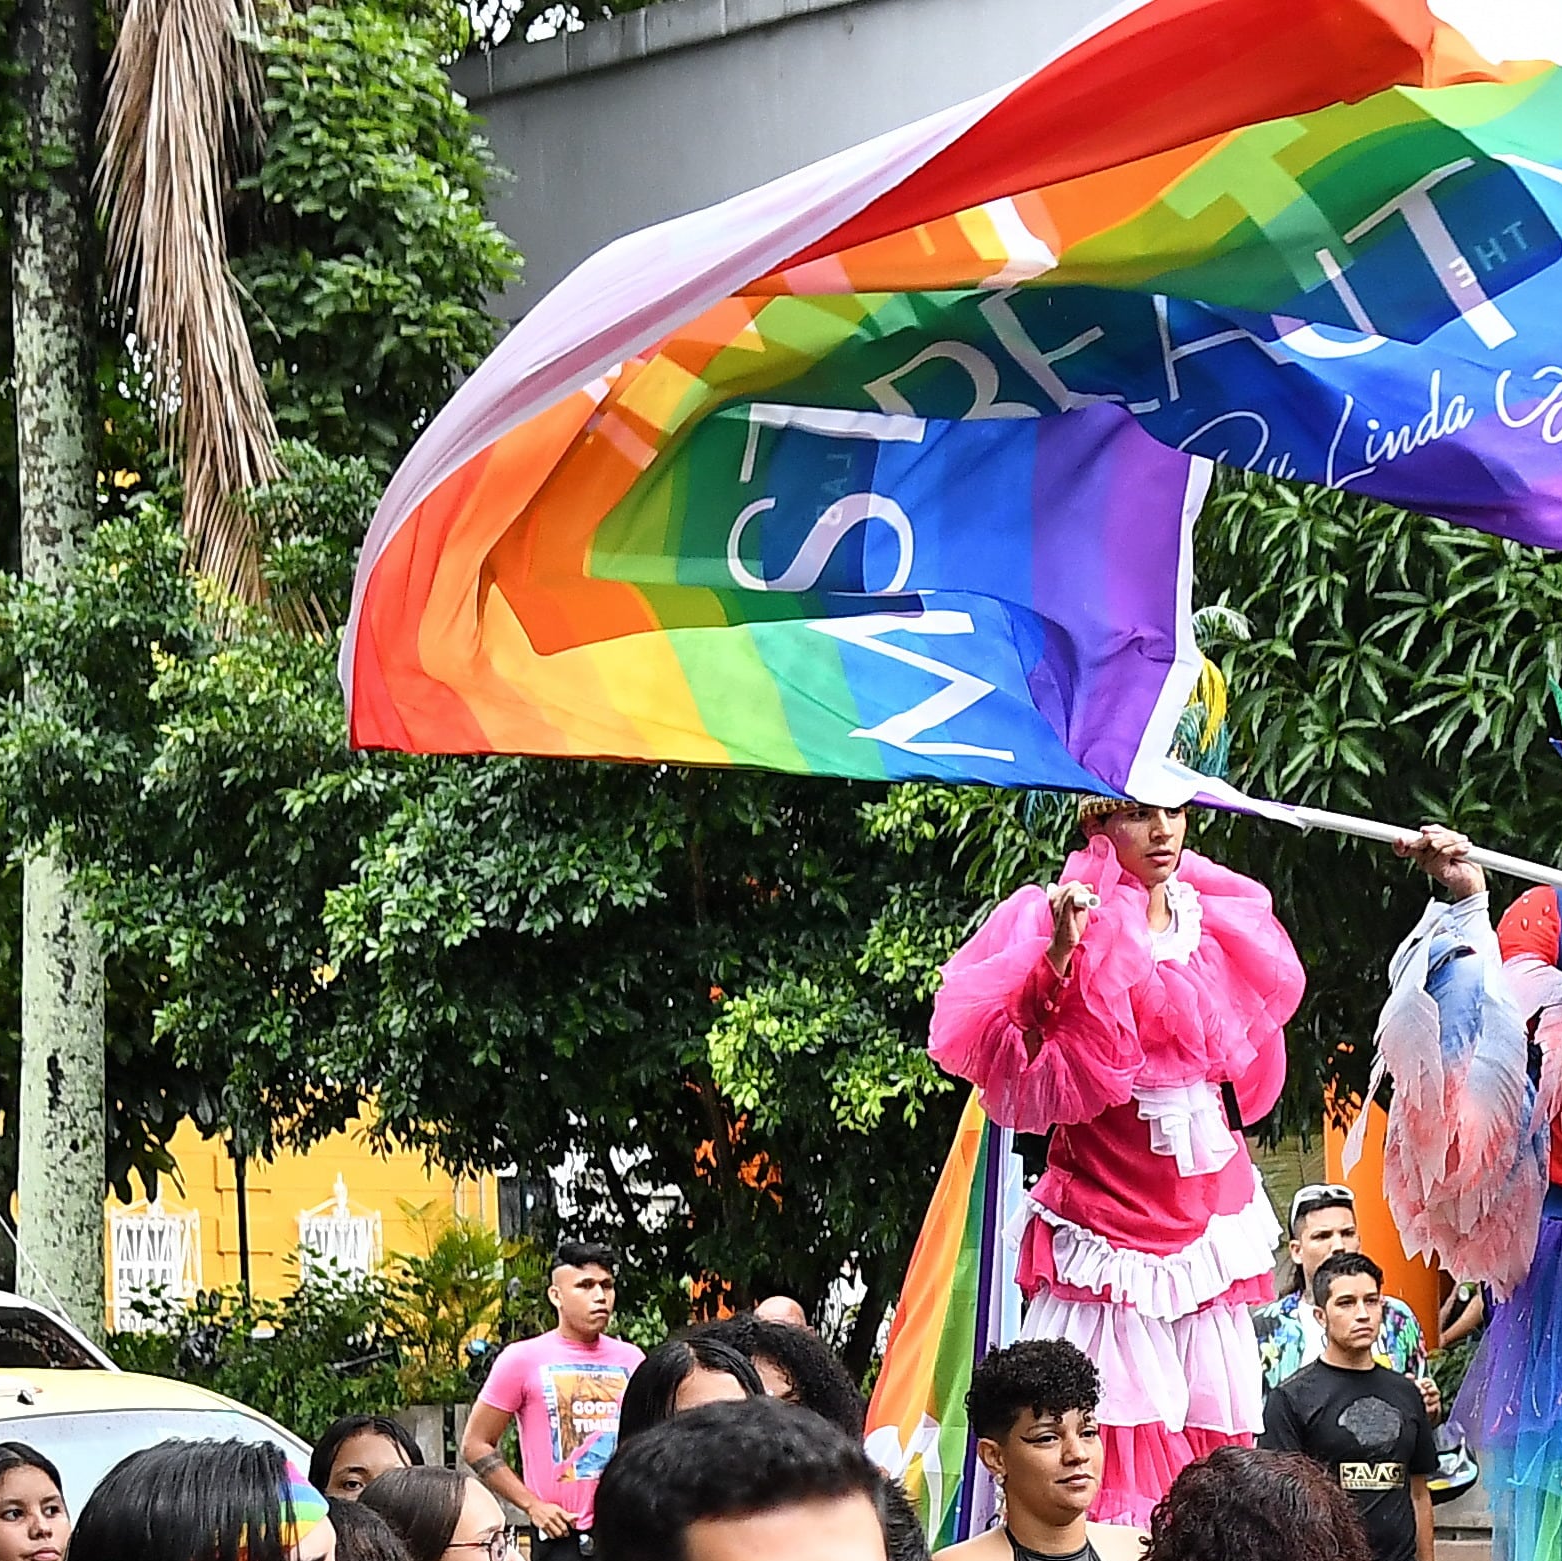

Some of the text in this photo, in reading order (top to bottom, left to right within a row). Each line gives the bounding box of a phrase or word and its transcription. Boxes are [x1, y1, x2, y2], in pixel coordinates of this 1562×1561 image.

[1326, 369, 1473, 490] Linda
[572, 1401, 618, 1415] GOOD
[1343, 1463, 1403, 1481] SAVAG
